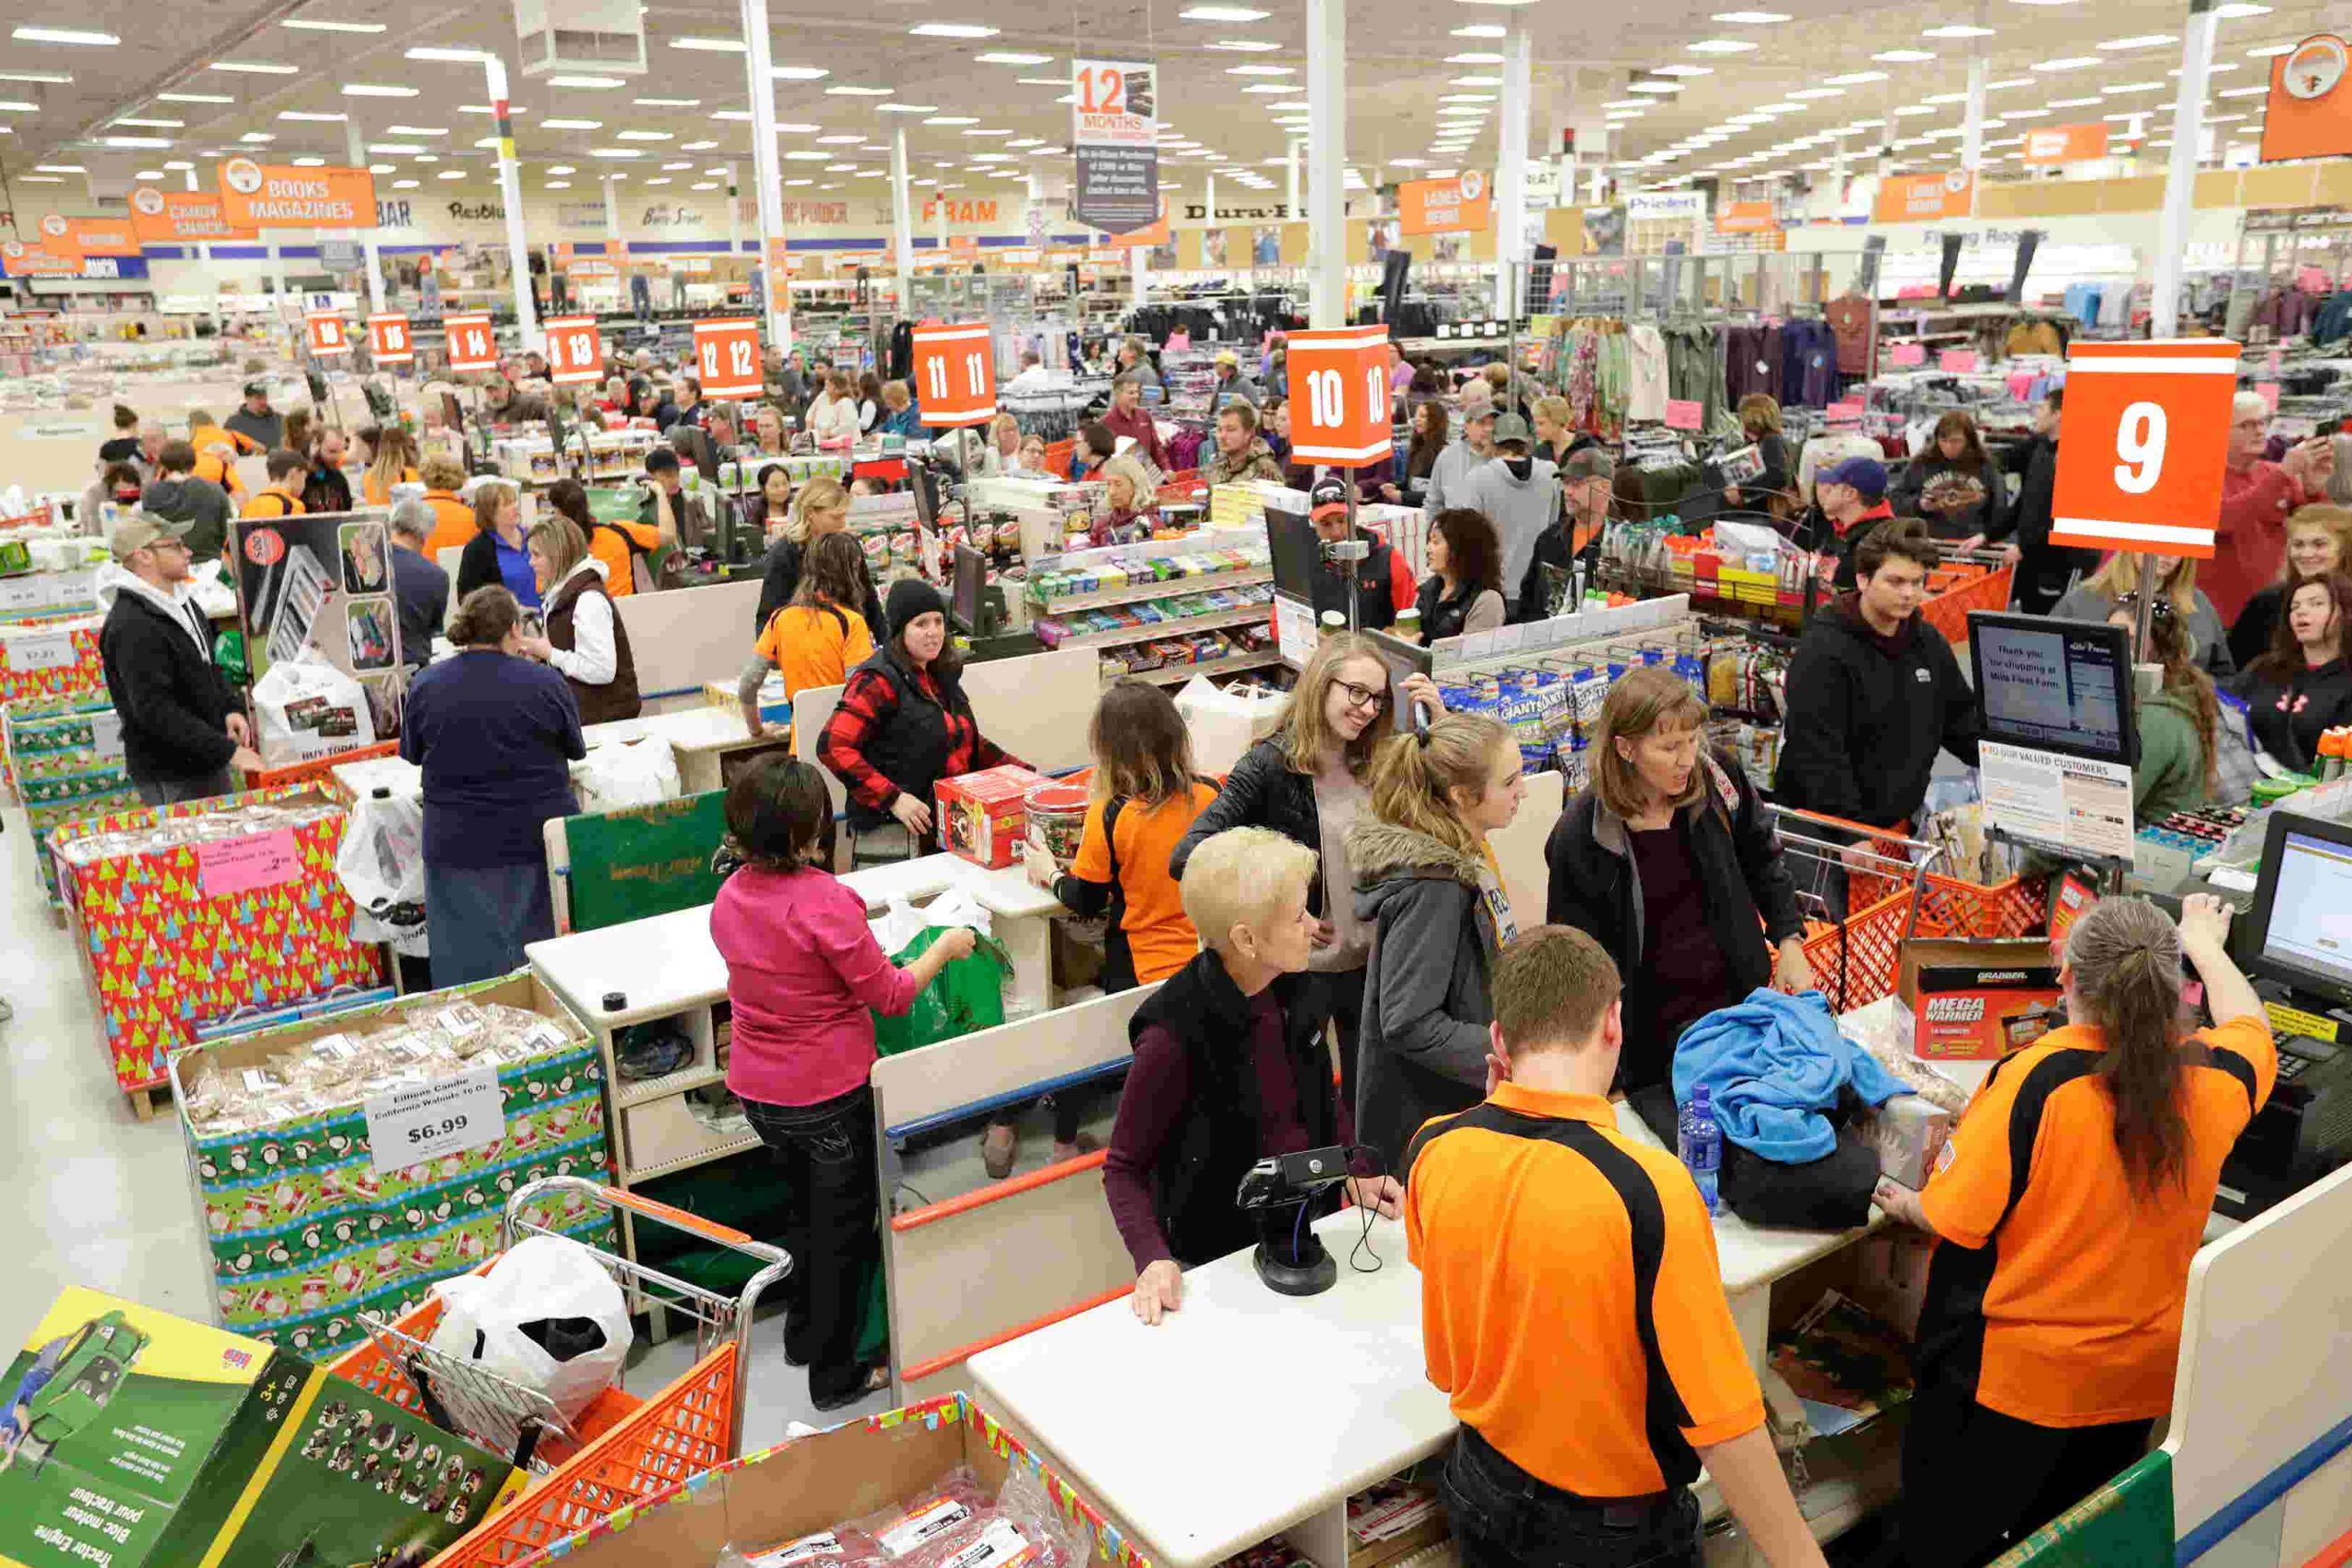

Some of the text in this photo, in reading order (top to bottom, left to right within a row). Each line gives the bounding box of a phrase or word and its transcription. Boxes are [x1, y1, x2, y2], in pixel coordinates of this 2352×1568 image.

[1077, 68, 1125, 114] 12
[1084, 116, 1142, 130] MONTHS
[268, 180, 328, 198] BOOKS
[249, 200, 354, 220] MAGAZINES
[922, 199, 997, 222] FRAM
[568, 333, 593, 366] 13
[702, 340, 753, 378] 12 12
[926, 352, 986, 400] 11 11
[1306, 365, 1385, 428] 10 10
[2114, 400, 2167, 494] 9
[2005, 660, 2046, 675] shopping
[1500, 700, 1544, 720] GIANTS
[2019, 750, 2052, 766] VALUED
[2054, 757, 2109, 777] CUSTOMERS
[1925, 1010, 1984, 1021] WARMER
[1927, 998, 1985, 1011] MEGA
[374, 1103, 421, 1120] California
[423, 1092, 460, 1107] Walnuts
[408, 1114, 468, 1144] $6.99
[62, 1505, 104, 1530] moteur
[68, 1486, 144, 1524] pour tracteur
[33, 1523, 115, 1568] Tractor Engine
